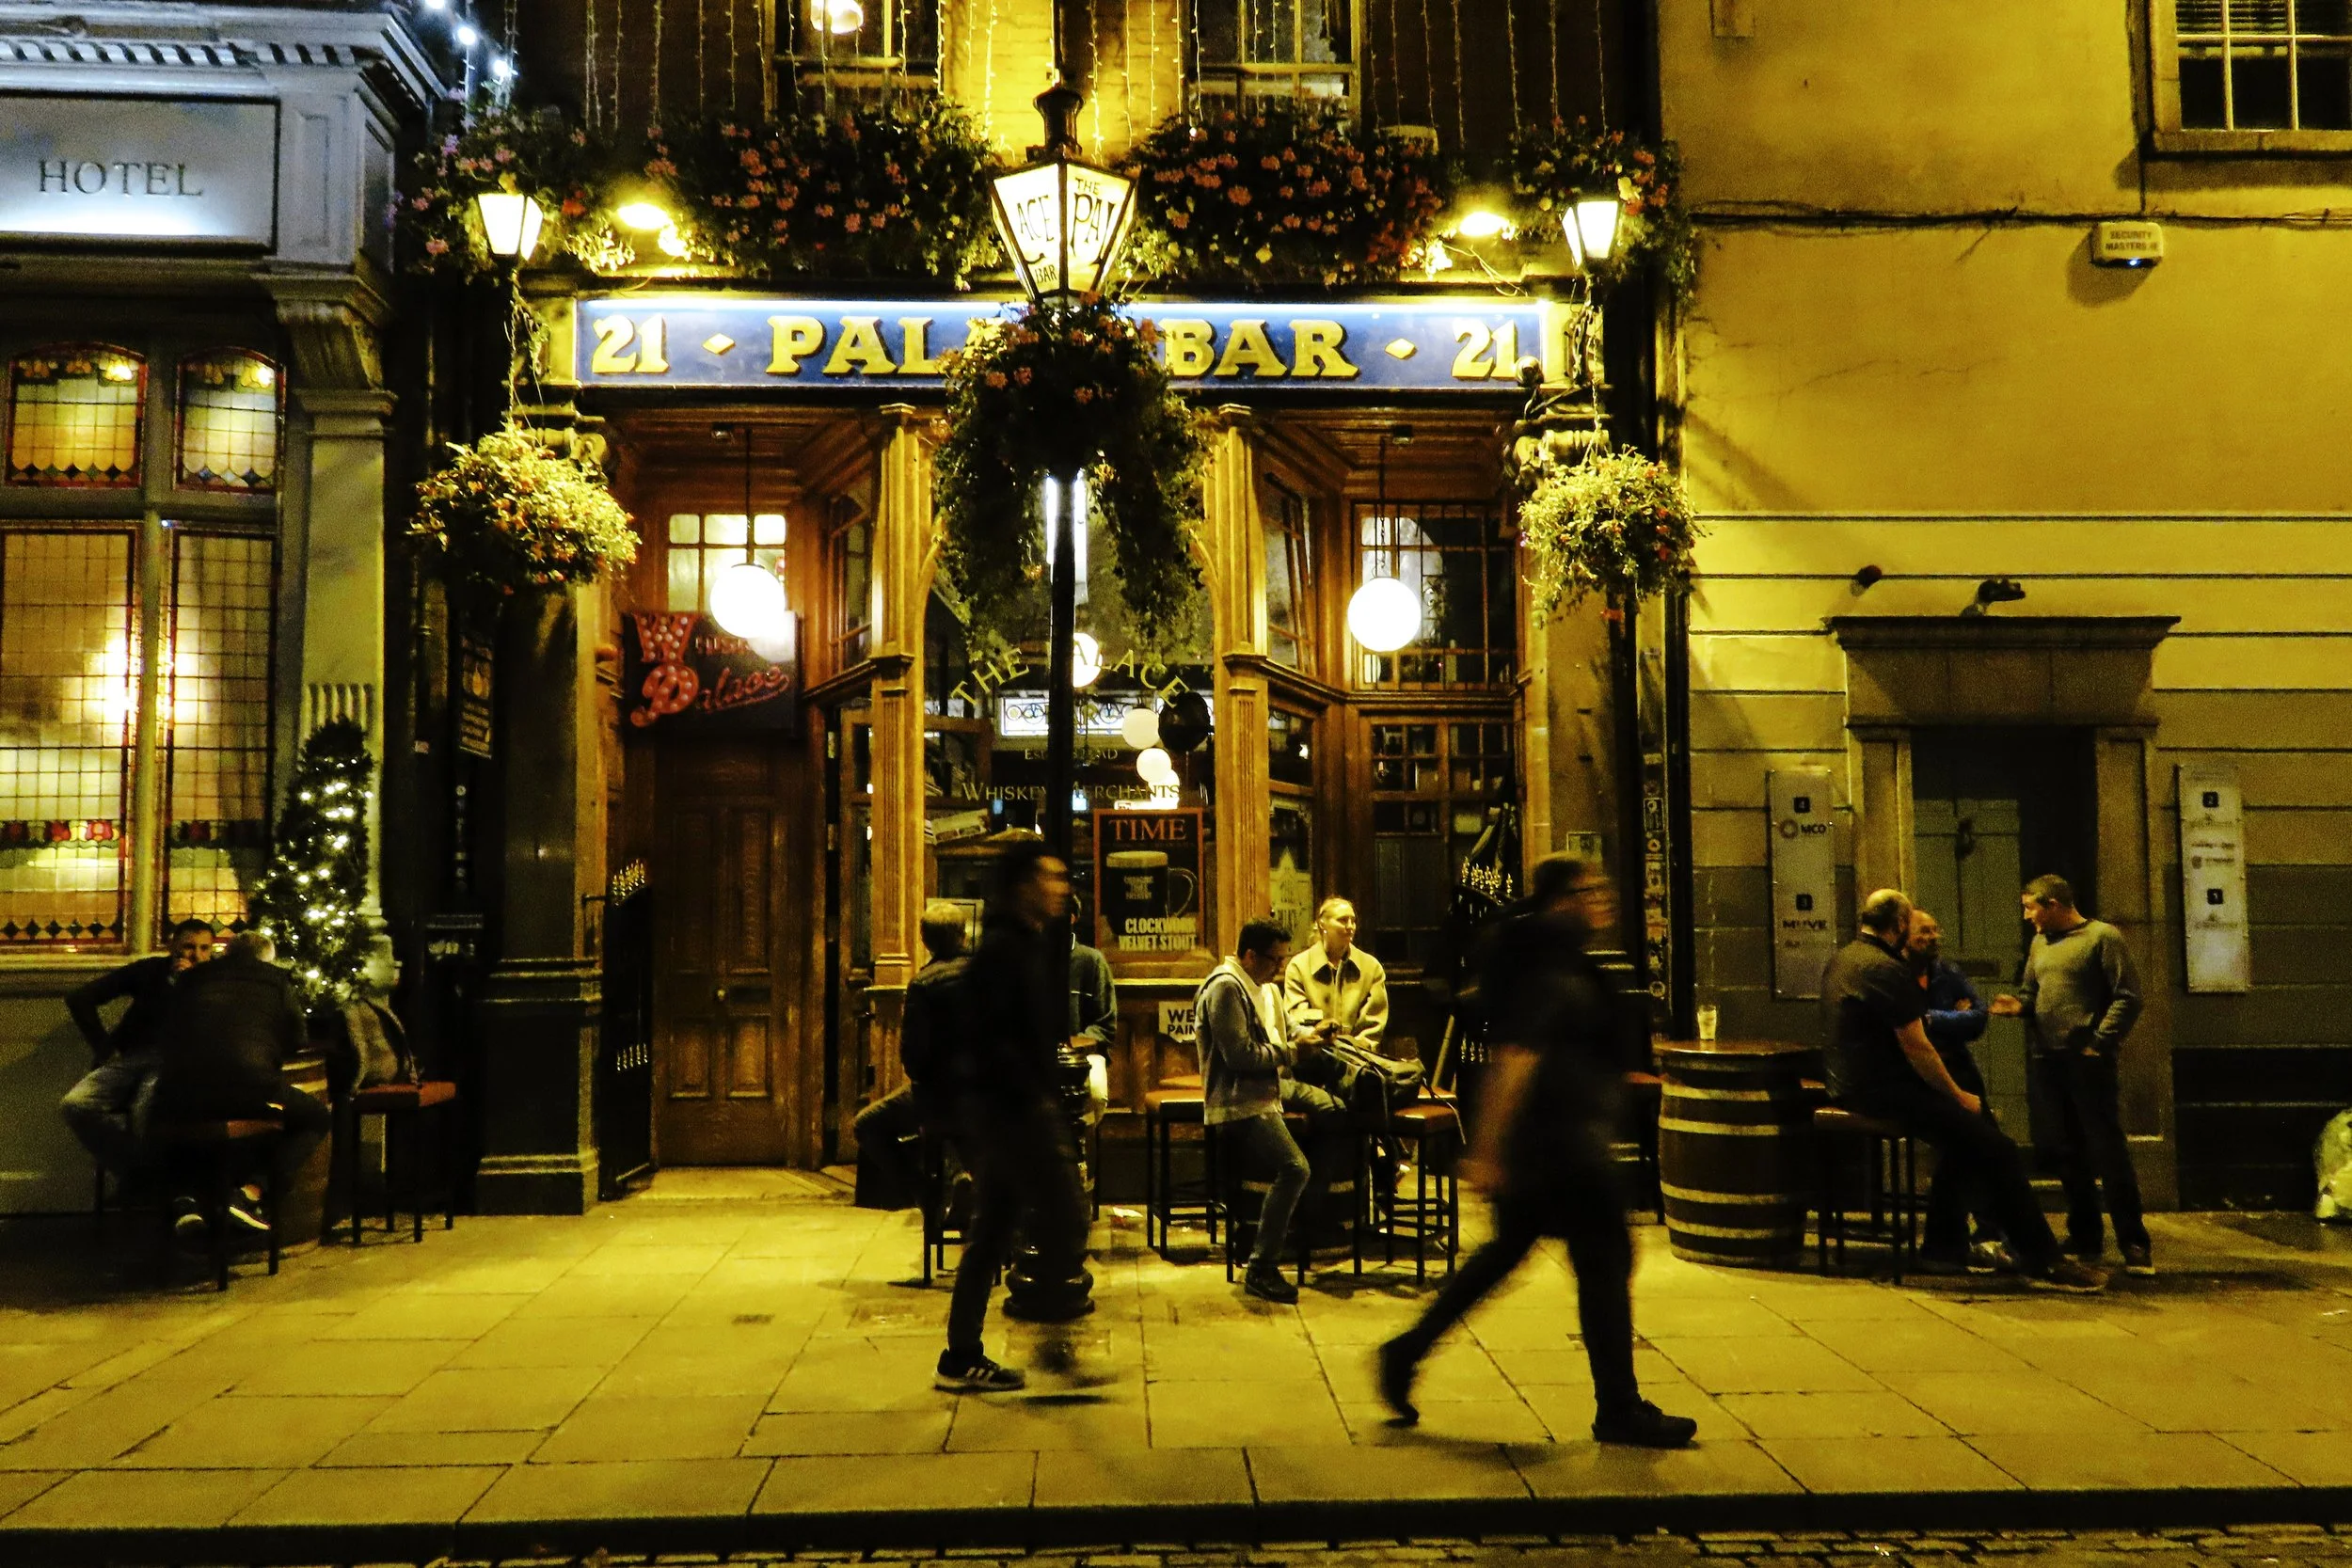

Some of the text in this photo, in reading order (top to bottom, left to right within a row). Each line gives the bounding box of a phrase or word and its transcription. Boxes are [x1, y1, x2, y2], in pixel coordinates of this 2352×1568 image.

[39, 159, 204, 196] HOTEL
[1074, 177, 1101, 196] THE
[1034, 264, 1058, 284] BAR
[592, 314, 669, 374] 21
[1158, 318, 1361, 377] BAR
[1452, 318, 1519, 379] 21
[950, 640, 1190, 708] THE ALACE
[1108, 818, 1186, 841] TIME
[1159, 935, 1197, 951] STOUT
